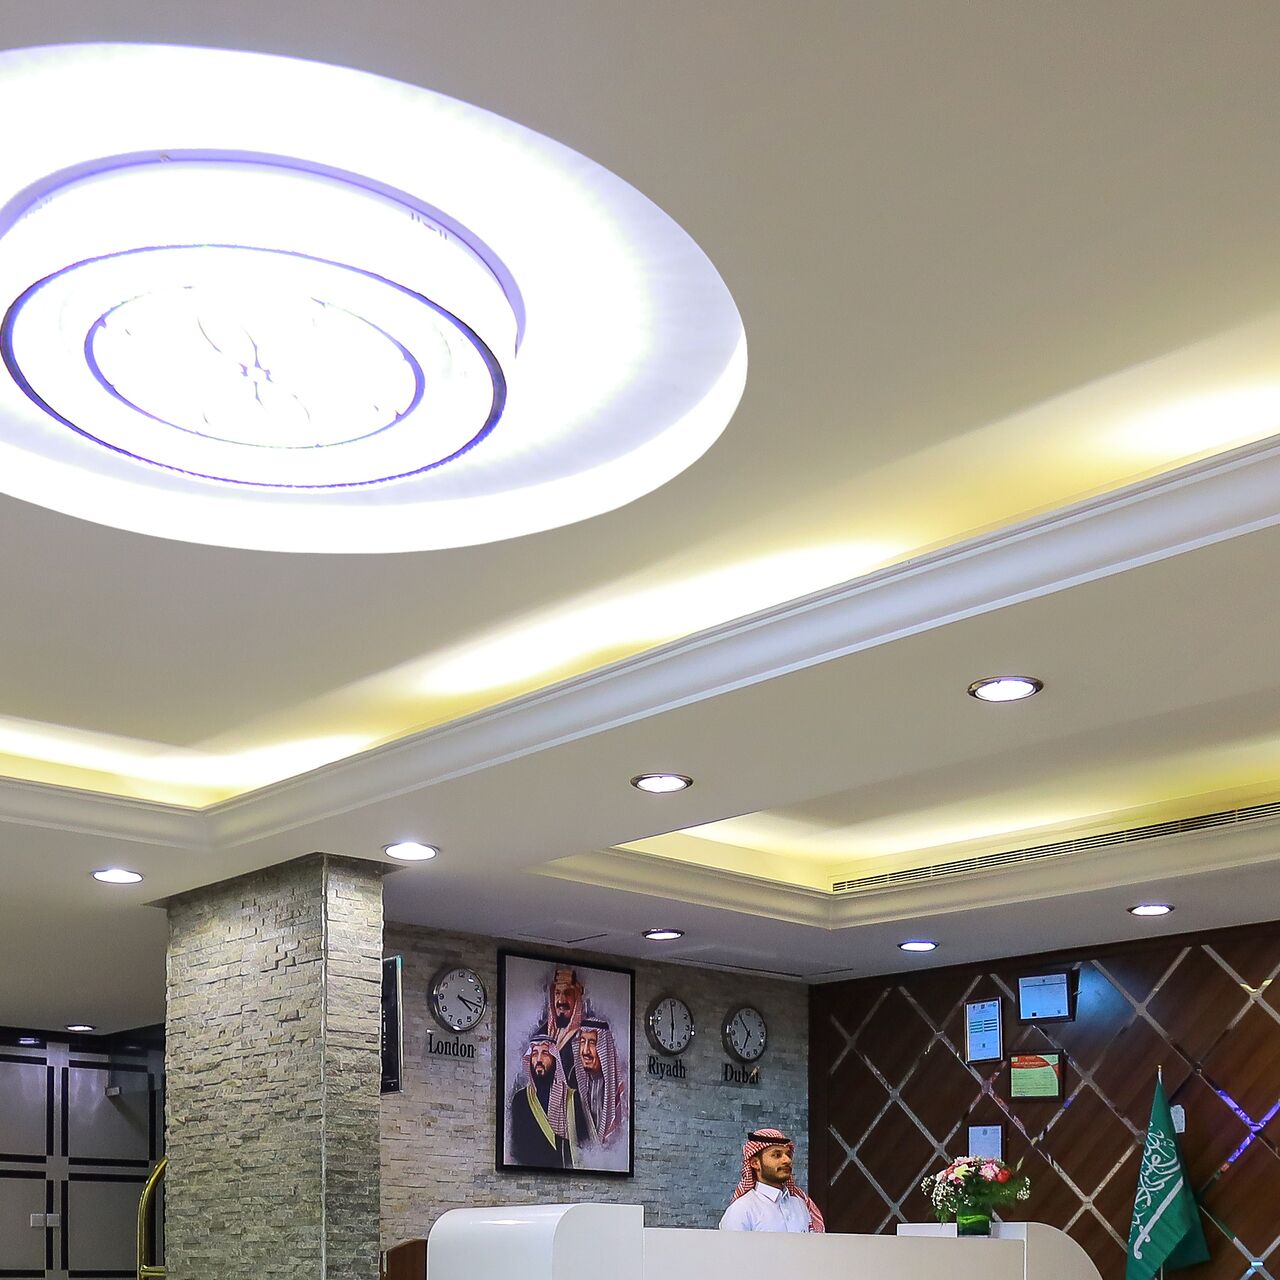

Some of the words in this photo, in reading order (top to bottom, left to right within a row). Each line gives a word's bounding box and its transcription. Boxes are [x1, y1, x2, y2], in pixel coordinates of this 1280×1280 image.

[429, 1034, 475, 1058] London
[648, 1055, 686, 1079] Riyadh
[725, 1063, 759, 1084] Dubai
